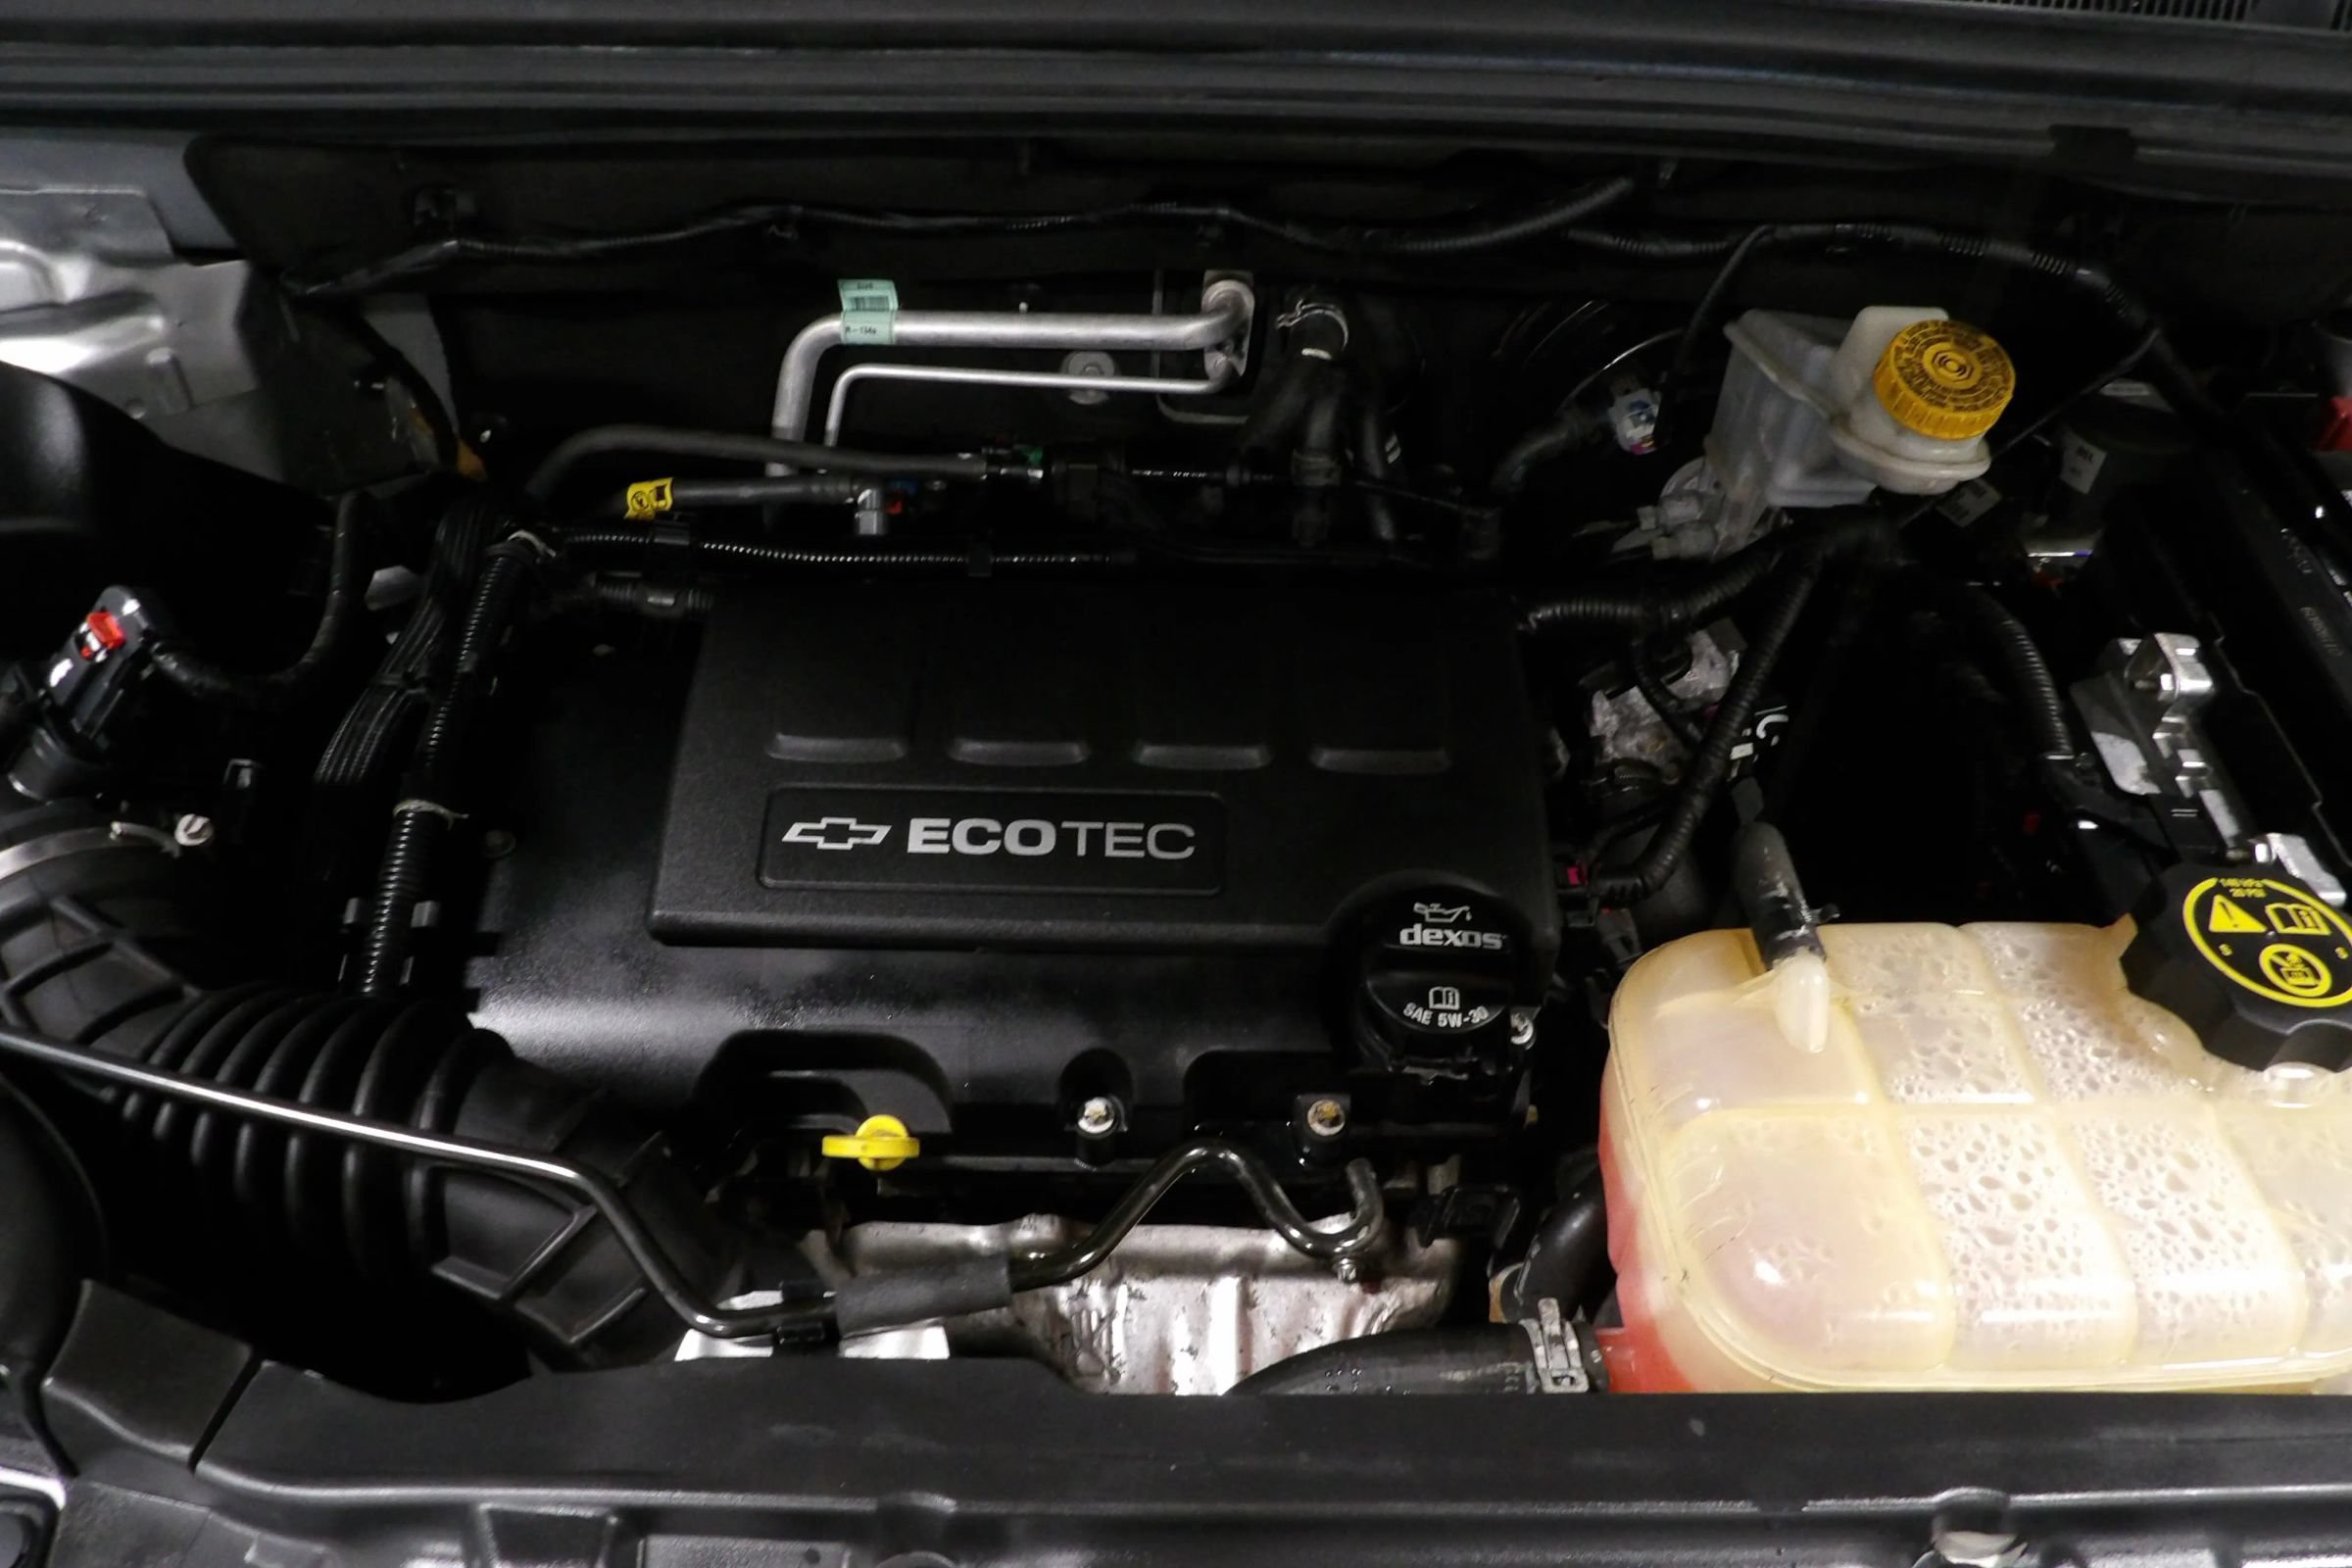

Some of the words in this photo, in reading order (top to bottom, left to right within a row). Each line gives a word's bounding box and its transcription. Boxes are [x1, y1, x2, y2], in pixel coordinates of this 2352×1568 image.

[906, 817, 1196, 860] ECOTEC
[1399, 923, 1503, 950] dexos
[1402, 1002, 1434, 1026] SAE
[1437, 1005, 1490, 1028] 5W-30
